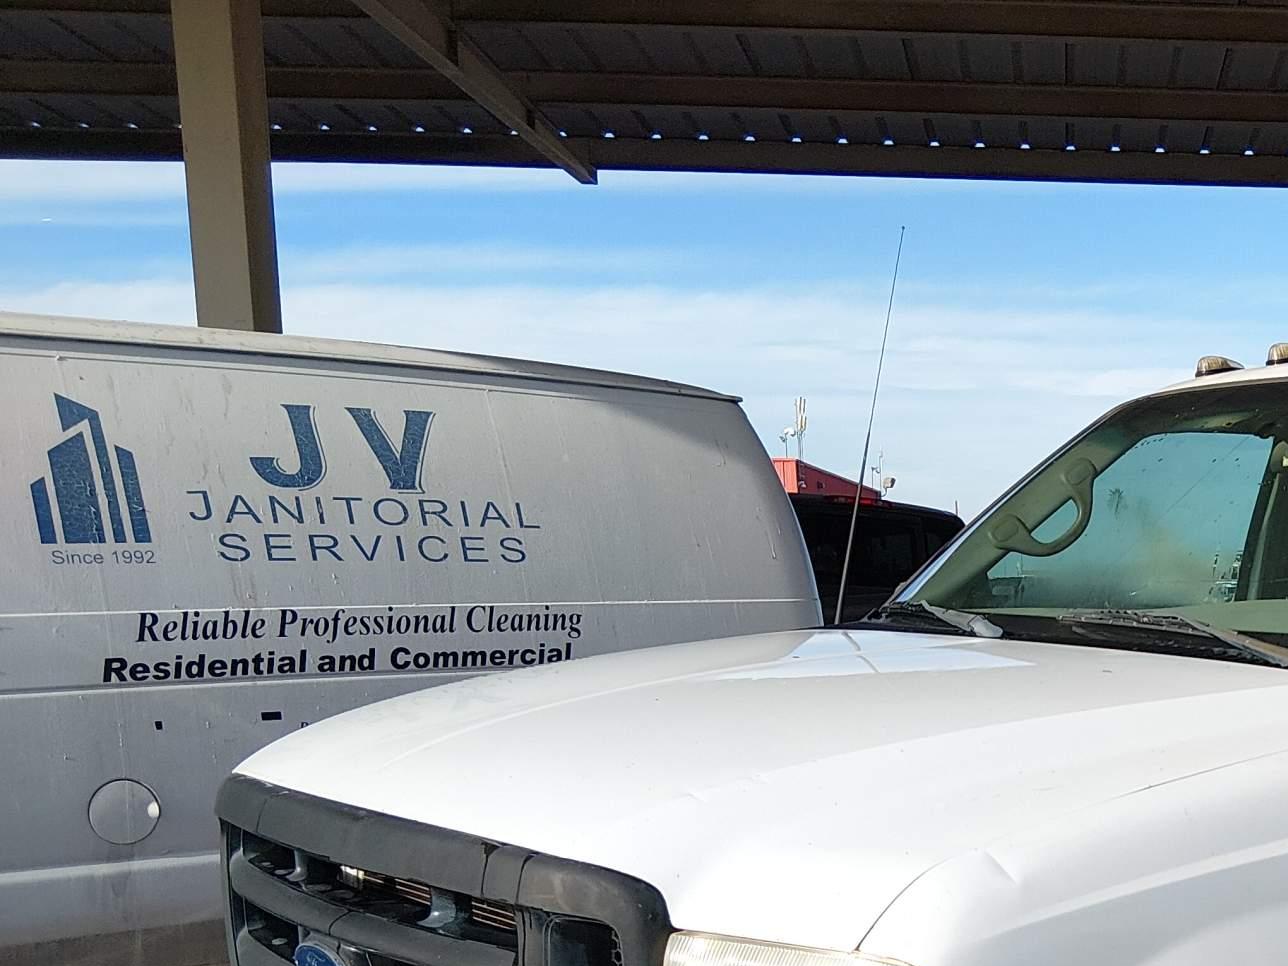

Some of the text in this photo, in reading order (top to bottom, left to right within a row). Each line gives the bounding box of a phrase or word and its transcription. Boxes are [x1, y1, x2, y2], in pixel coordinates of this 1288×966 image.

[186, 490, 541, 529] JANITORIAL
[51, 549, 156, 565] Since 1992
[217, 533, 526, 563] SERVICES
[136, 605, 582, 643] Reliable Professional Cleaning
[102, 642, 573, 682] Residential and Commercial
